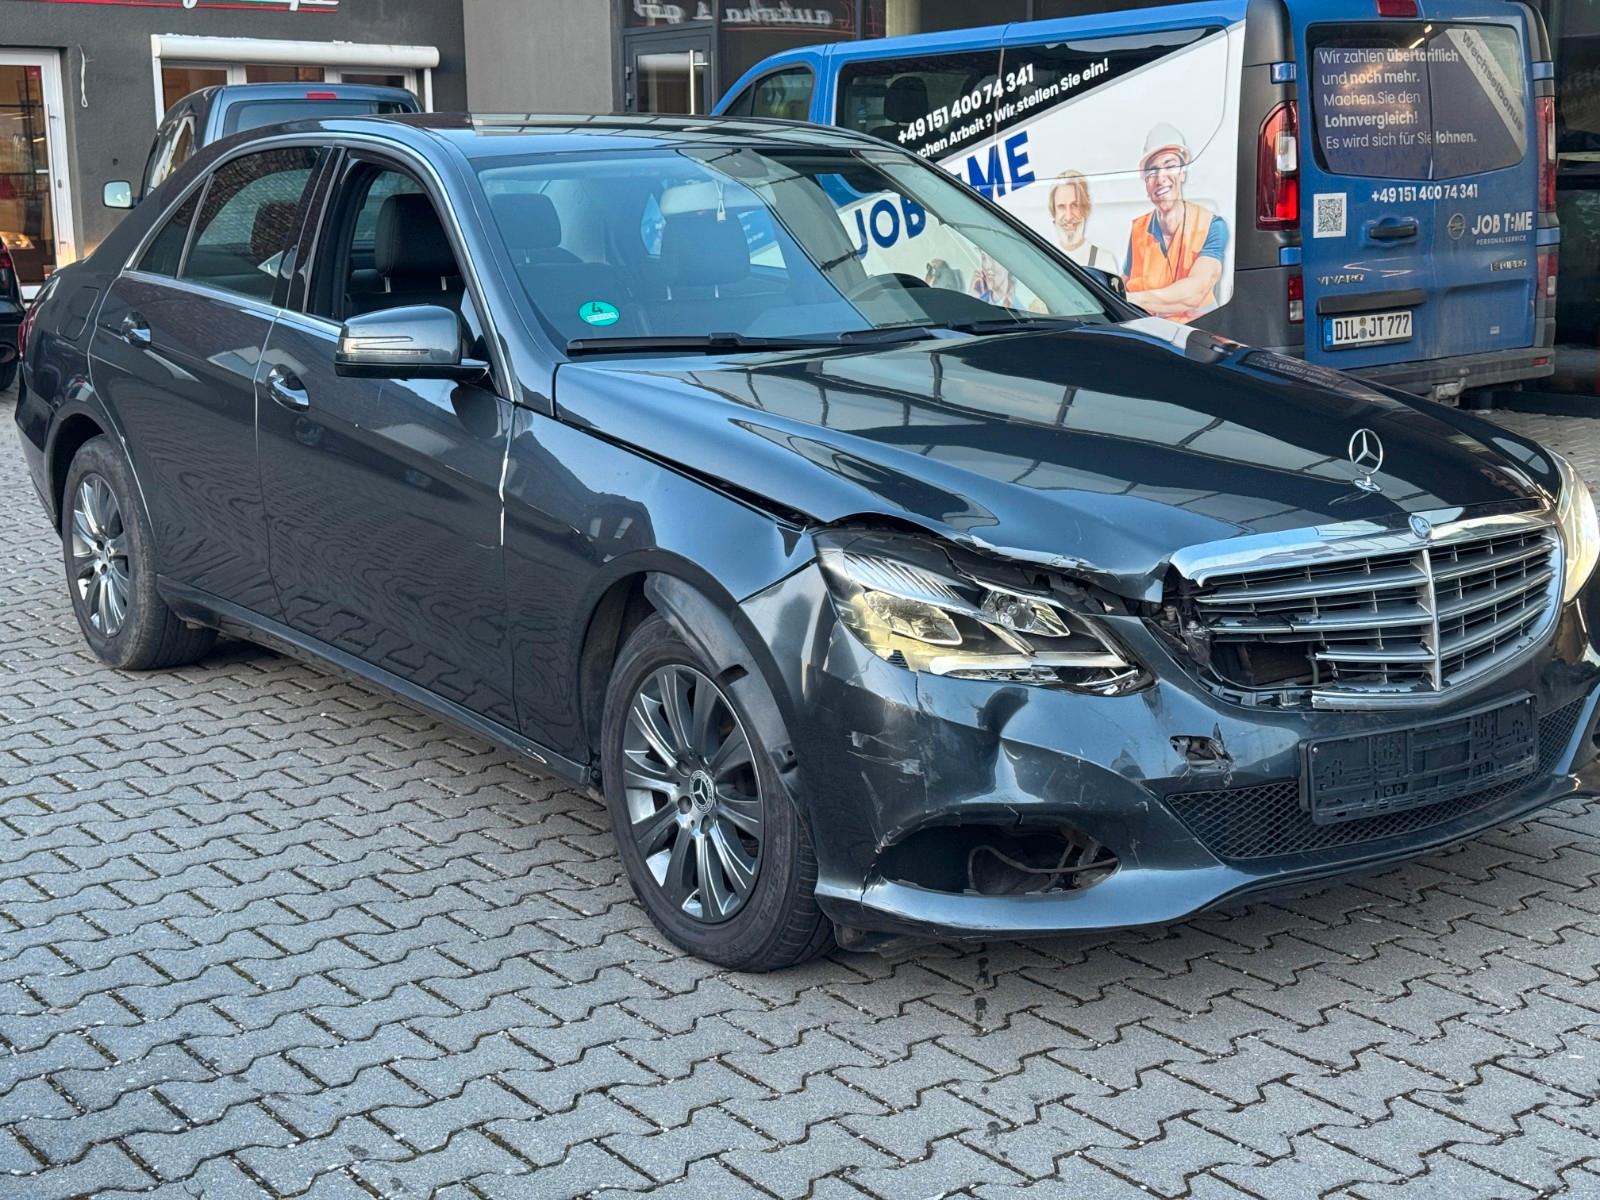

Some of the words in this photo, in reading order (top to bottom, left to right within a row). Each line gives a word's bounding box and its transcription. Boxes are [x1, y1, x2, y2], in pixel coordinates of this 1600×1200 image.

[1320, 50, 1340, 64] Wir
[1344, 49, 1384, 63] zahlen
[1387, 48, 1458, 62] übertariflich
[1322, 71, 1347, 85] und
[1349, 70, 1382, 84] noch
[1384, 70, 1420, 83] mehr.
[898, 118, 926, 144] +49
[926, 106, 949, 131] 151
[951, 91, 982, 119] 400
[983, 79, 1004, 104] 74
[1005, 63, 1034, 92] 341
[916, 137, 948, 158] chen
[950, 118, 985, 146] Arbeit
[985, 113, 992, 128] ?
[993, 104, 1015, 123] Wir
[1016, 83, 1059, 112] stellen
[1060, 72, 1081, 91] Sie
[1082, 58, 1109, 82] ein!
[1323, 92, 1375, 106] Machen
[1377, 91, 1395, 104] Sie
[1398, 90, 1420, 103] den
[1325, 110, 1418, 129] Lohnvergleich!
[1326, 136, 1339, 149] Es
[1343, 133, 1369, 148] wird
[1372, 132, 1396, 146] sich
[1400, 131, 1415, 145] für
[1417, 131, 1432, 145] Sie
[1436, 131, 1477, 144] lohnen.
[854, 198, 927, 260] JOB
[955, 131, 1036, 201] ME
[1371, 187, 1396, 203] +49
[1398, 186, 1416, 202] 151
[1419, 185, 1442, 200] 400
[1444, 184, 1457, 199] 74
[1460, 183, 1478, 199] 341
[1471, 214, 1500, 235] JOB
[1335, 319, 1359, 341] DIL
[1368, 316, 1384, 337] JT
[1387, 314, 1410, 335] 777
